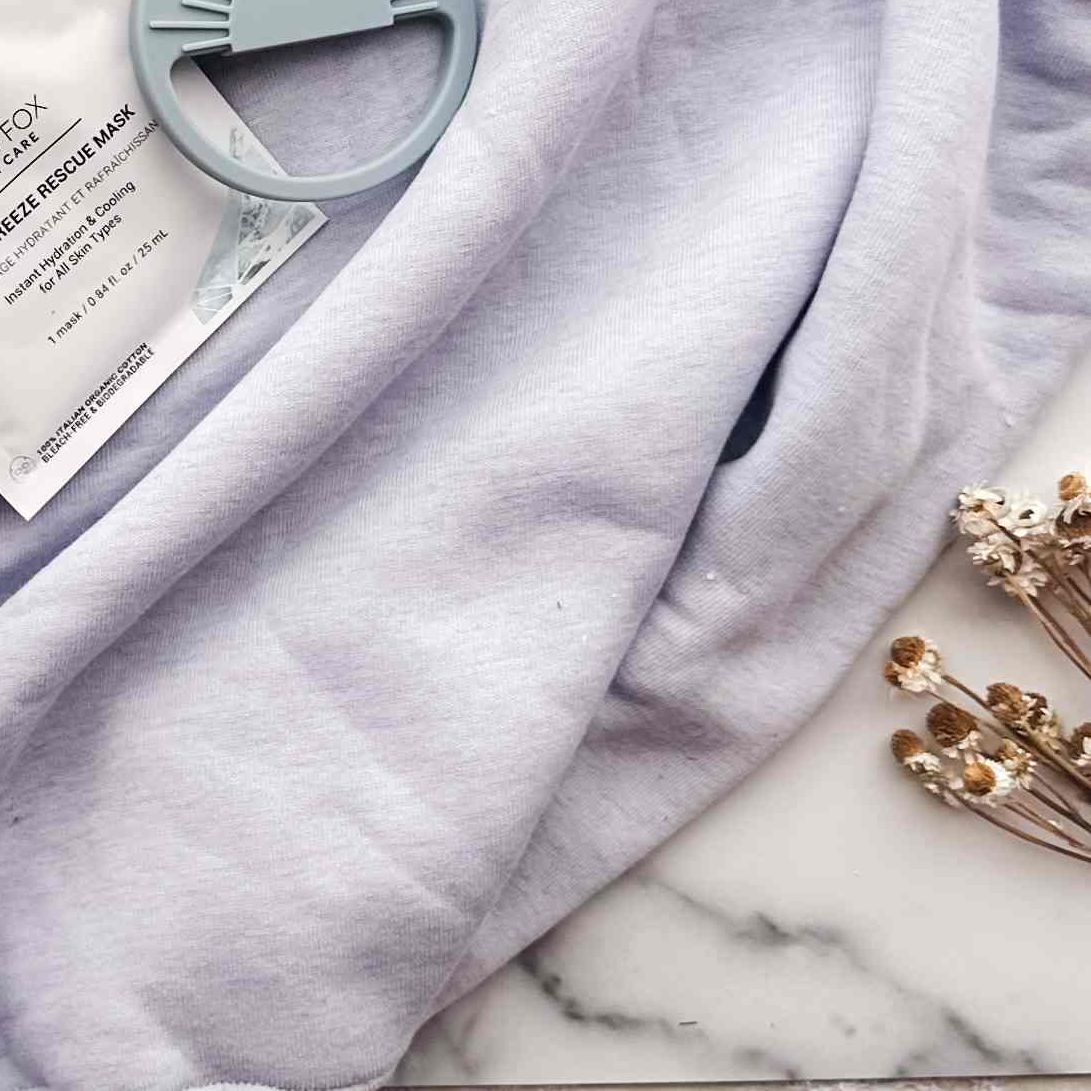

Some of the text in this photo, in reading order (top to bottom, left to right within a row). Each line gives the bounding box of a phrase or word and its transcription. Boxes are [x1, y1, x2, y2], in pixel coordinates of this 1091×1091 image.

[0, 94, 48, 142] FOX
[3, 131, 40, 165] CARE
[37, 142, 96, 199] RESCUE
[92, 103, 136, 149] MASK
[4, 181, 136, 305] Instant Hydration & Cooling
[13, 202, 71, 259] HYDRATANT
[70, 188, 85, 205] ET
[39, 213, 122, 294] for All Skin Types
[48, 334, 57, 345] 1
[56, 311, 83, 338] mask
[120, 262, 133, 276] oz
[137, 242, 153, 258] 25
[151, 229, 169, 247] mL
[36, 342, 148, 455] 100% ITALIAN ORGANIC COTTON
[40, 347, 154, 463] BLEACH-FREE & BIODEGRADABLE
